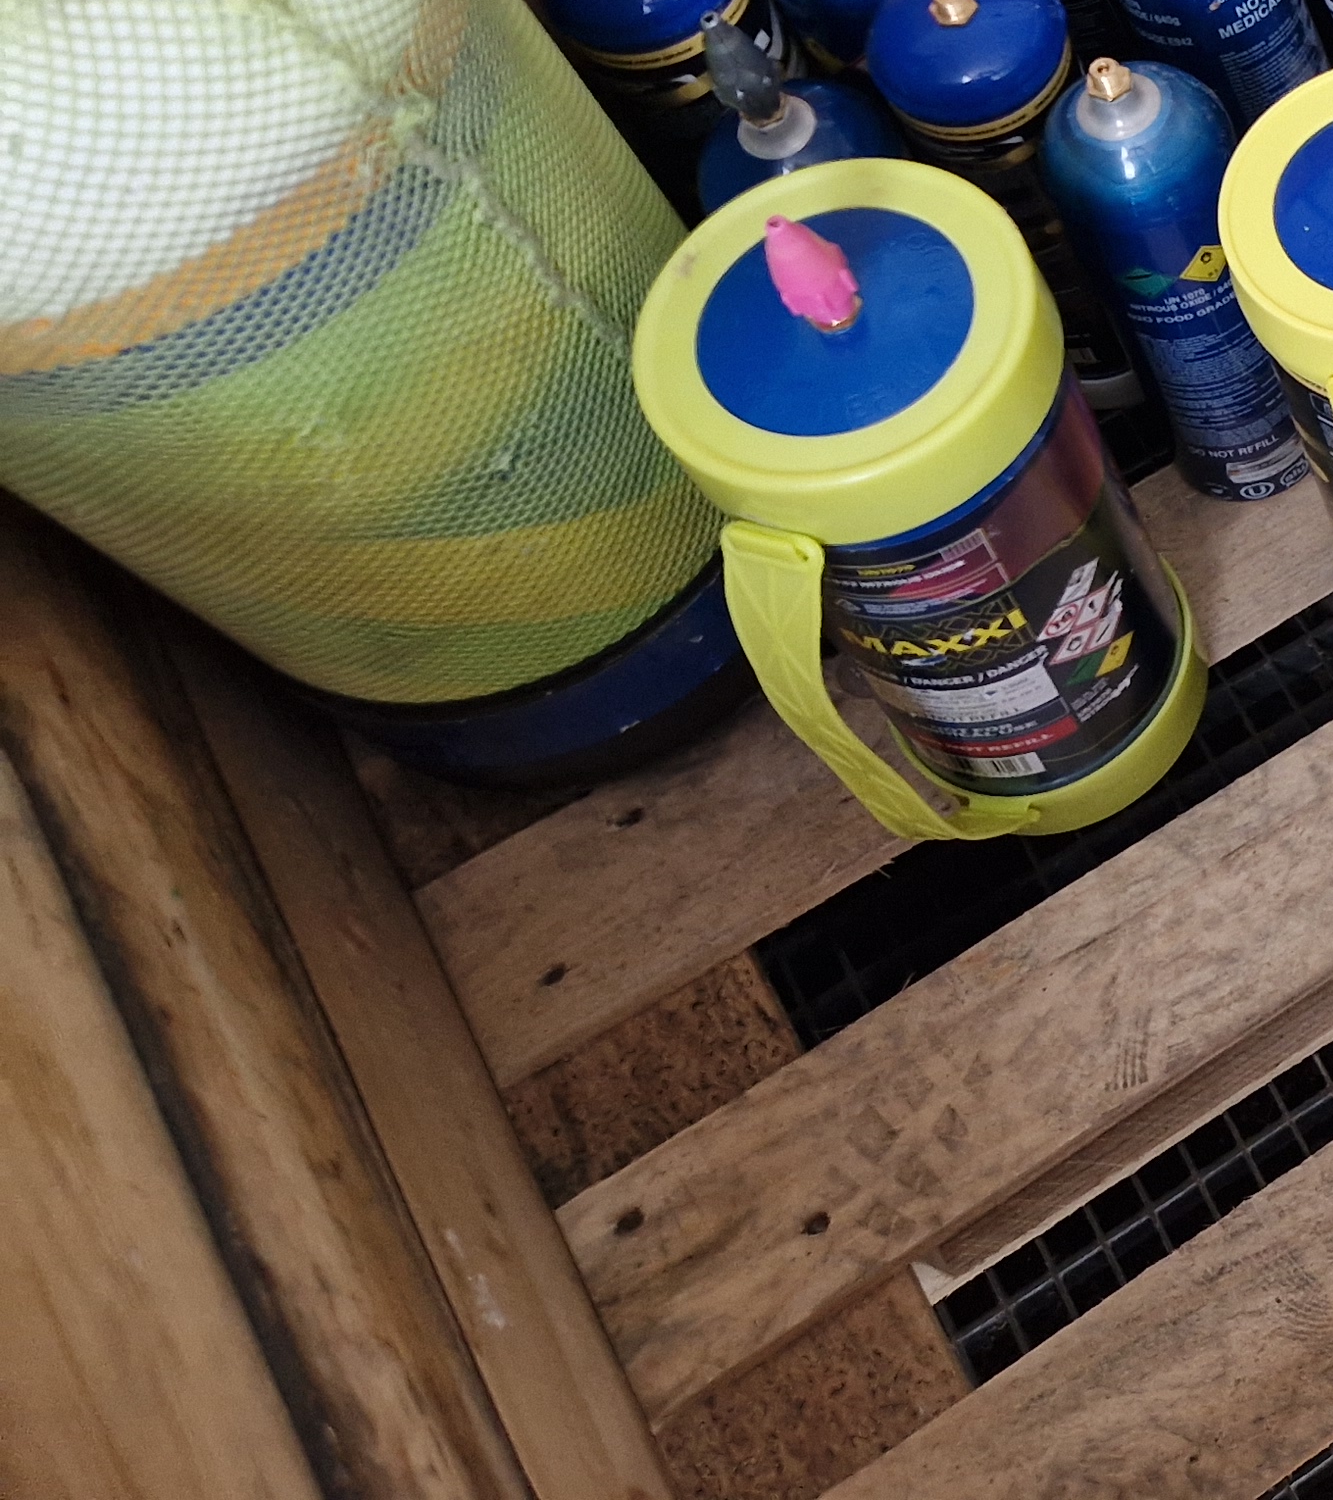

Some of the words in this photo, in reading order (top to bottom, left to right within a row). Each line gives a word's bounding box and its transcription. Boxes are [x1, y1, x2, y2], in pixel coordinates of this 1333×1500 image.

[1179, 292, 1213, 310] OXIDE
[1156, 312, 1194, 324] FOOD
[1207, 448, 1235, 459] NOT
[1237, 433, 1281, 458] REFILL
[909, 673, 975, 686] DANGER
